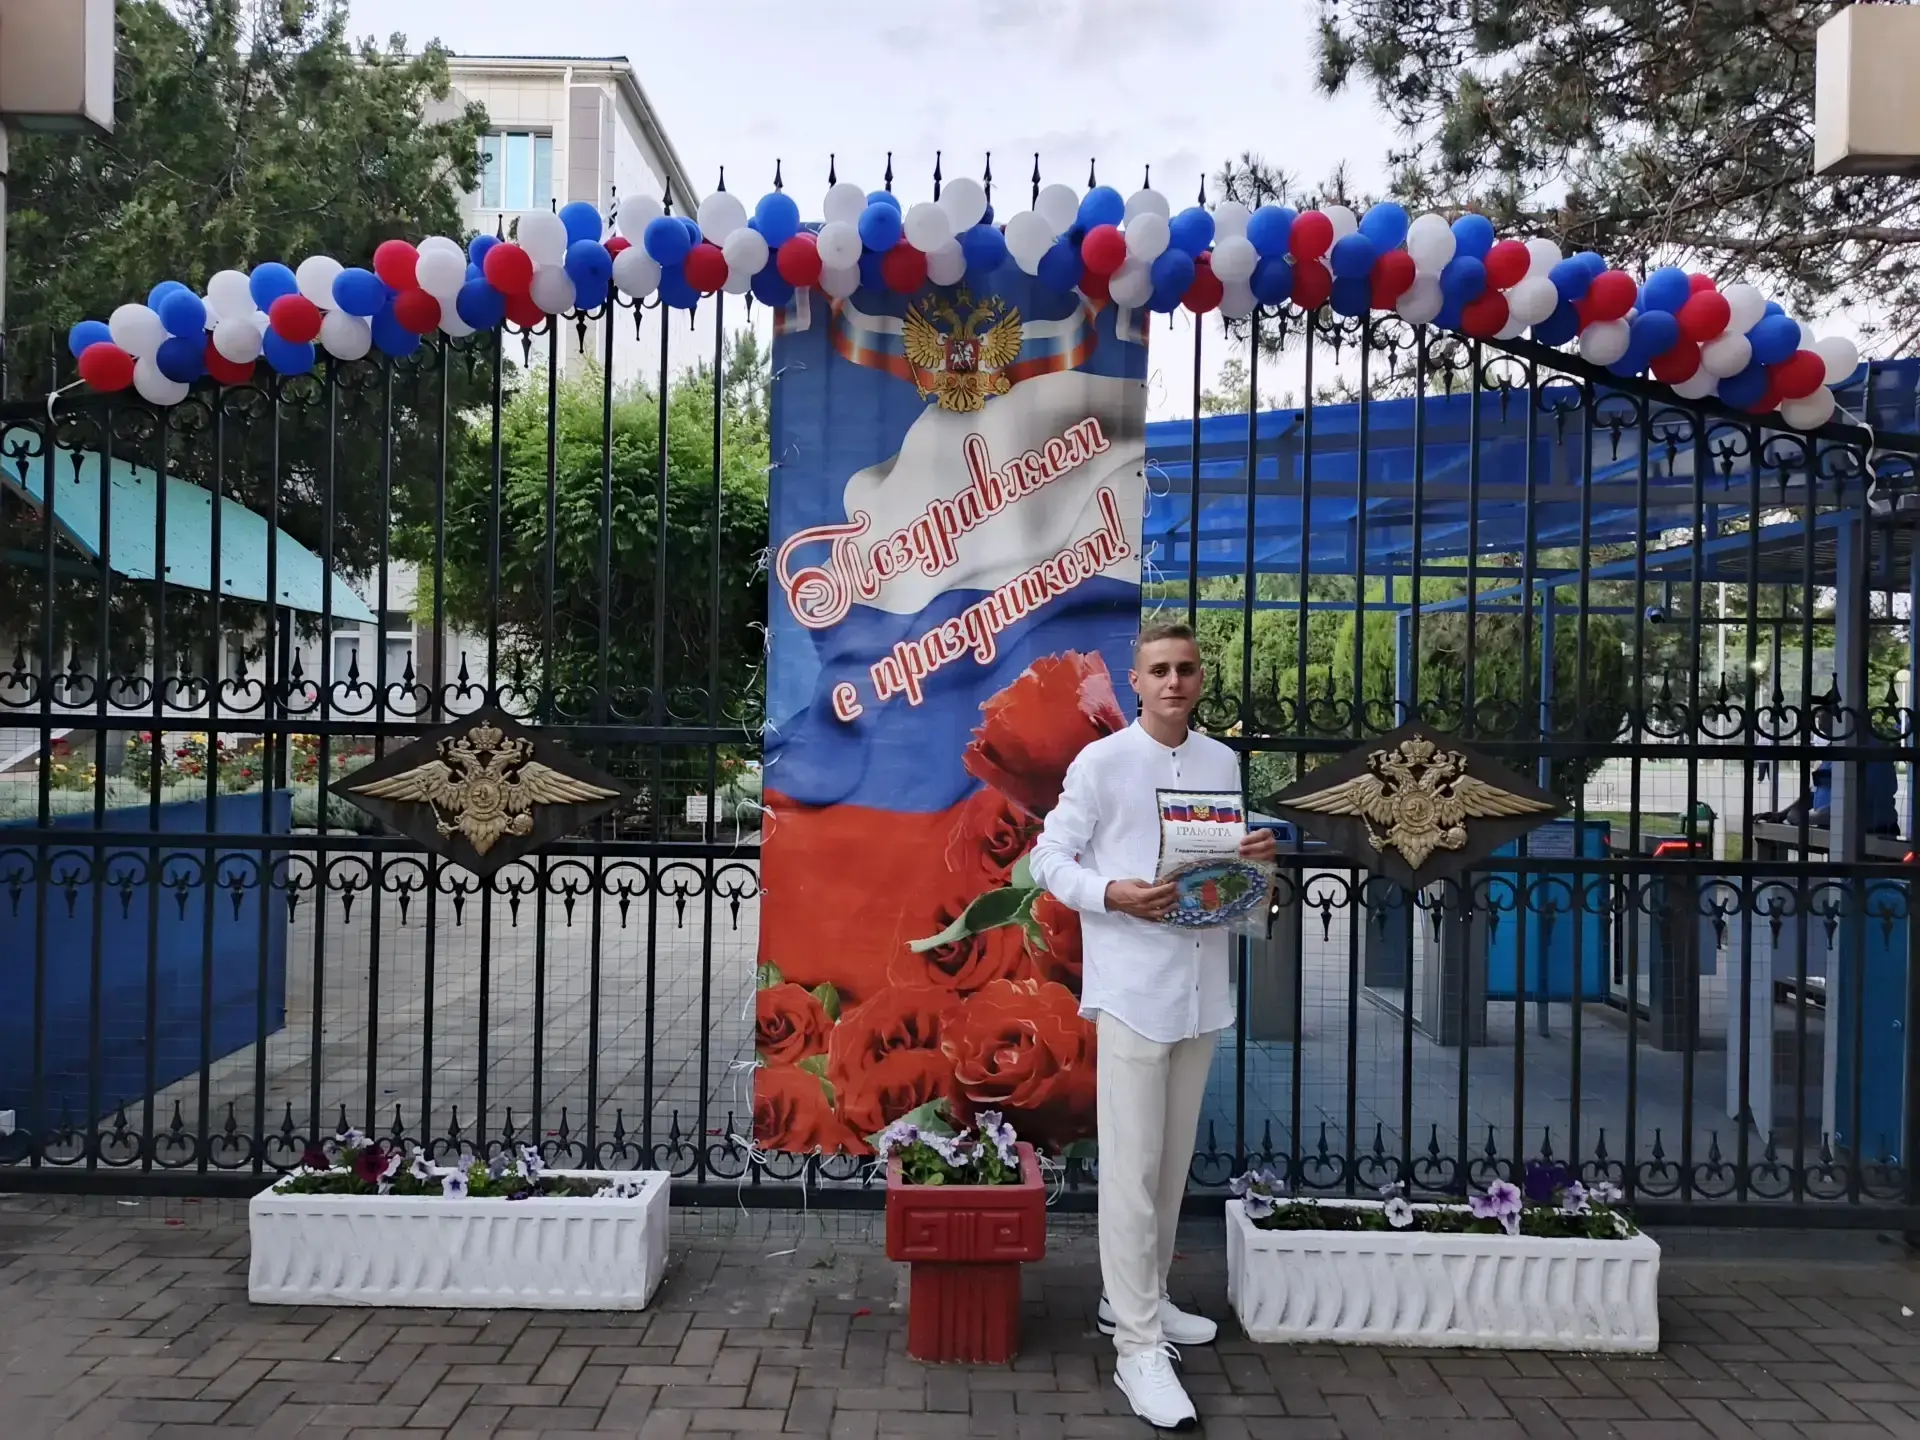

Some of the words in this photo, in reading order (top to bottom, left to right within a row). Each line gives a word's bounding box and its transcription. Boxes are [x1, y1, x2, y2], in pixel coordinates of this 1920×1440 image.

[776, 417, 1110, 628] Поздравляем
[832, 682, 863, 721] с
[870, 487, 1130, 706] праздником!
[1176, 826, 1232, 837] ГРАМОТА
